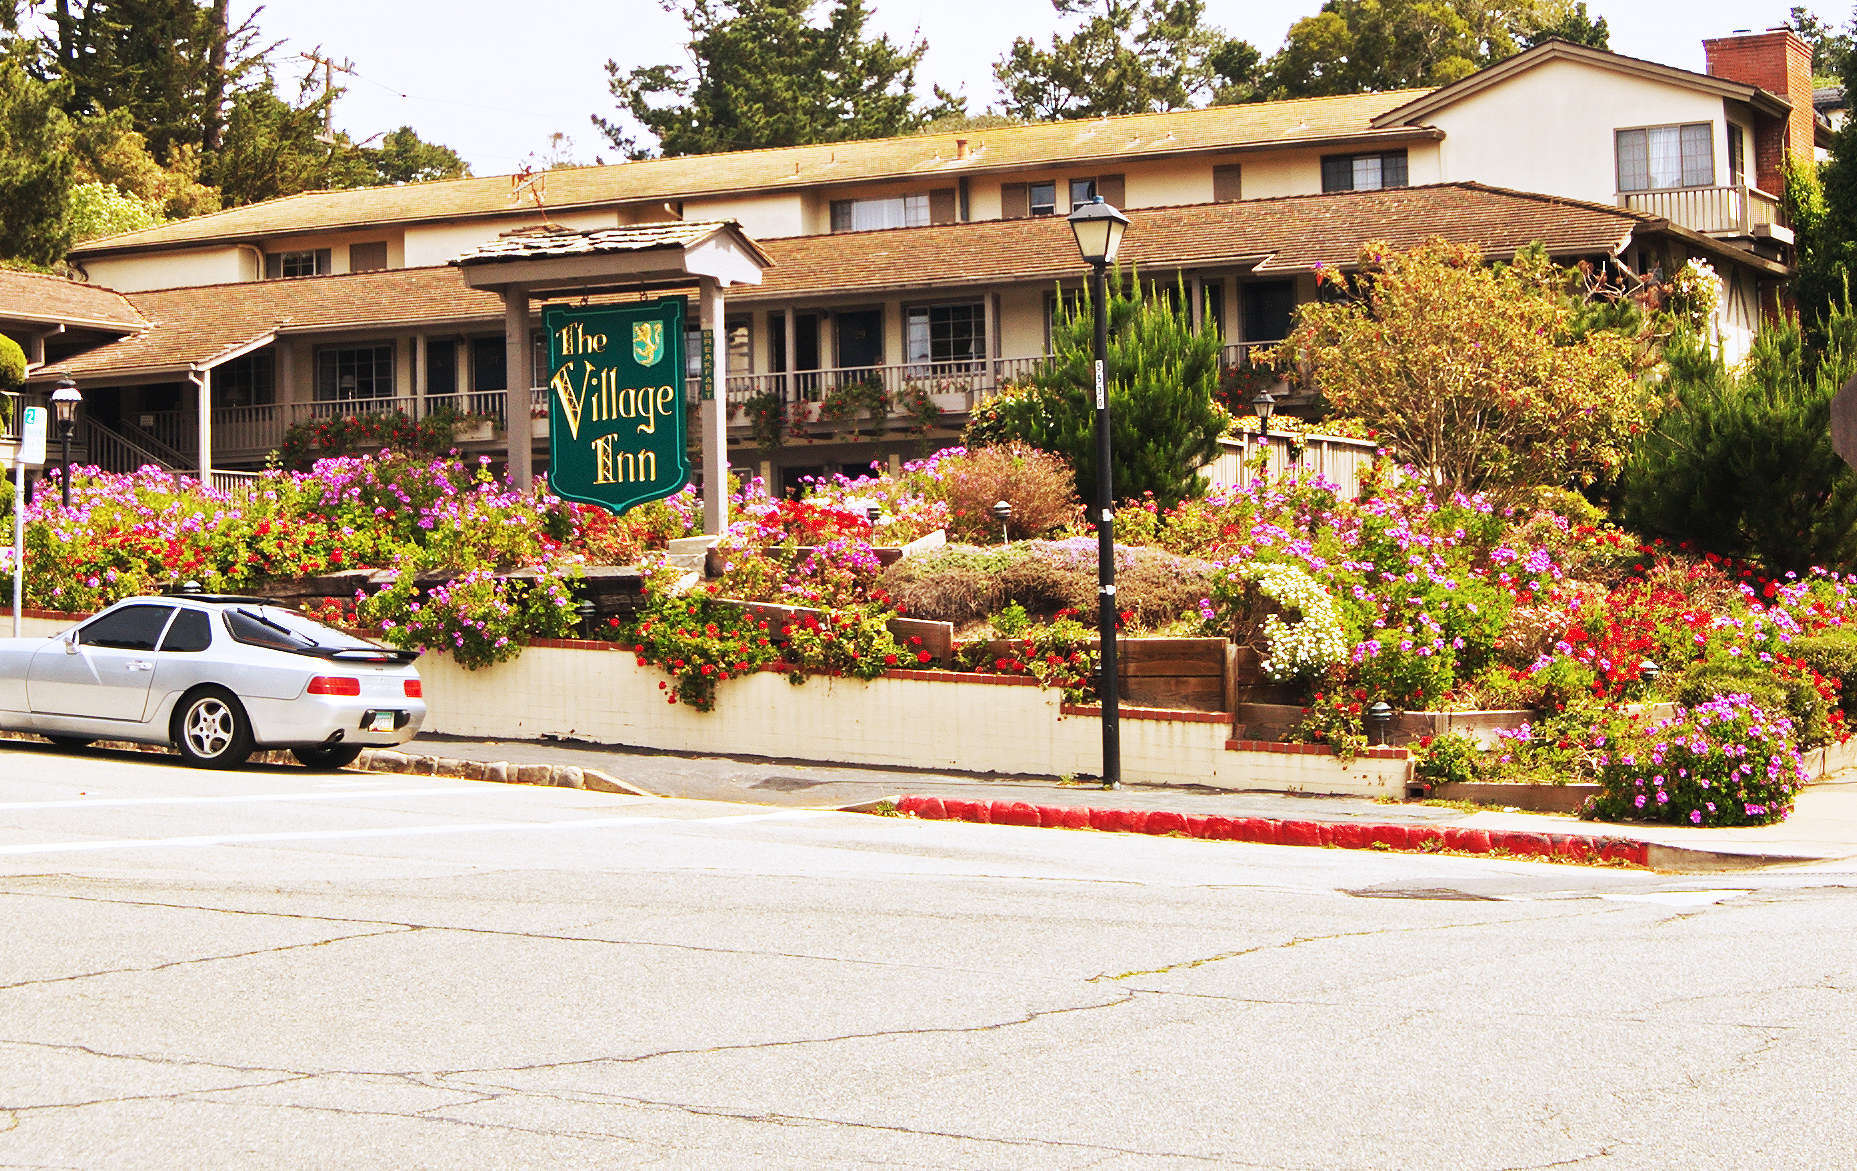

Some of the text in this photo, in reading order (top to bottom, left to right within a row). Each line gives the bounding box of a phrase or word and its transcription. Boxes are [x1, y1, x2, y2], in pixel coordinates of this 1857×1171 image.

[555, 321, 608, 356] The
[703, 331, 712, 399] BREAKFAST
[551, 360, 674, 441] Village
[591, 433, 656, 485] Inn
